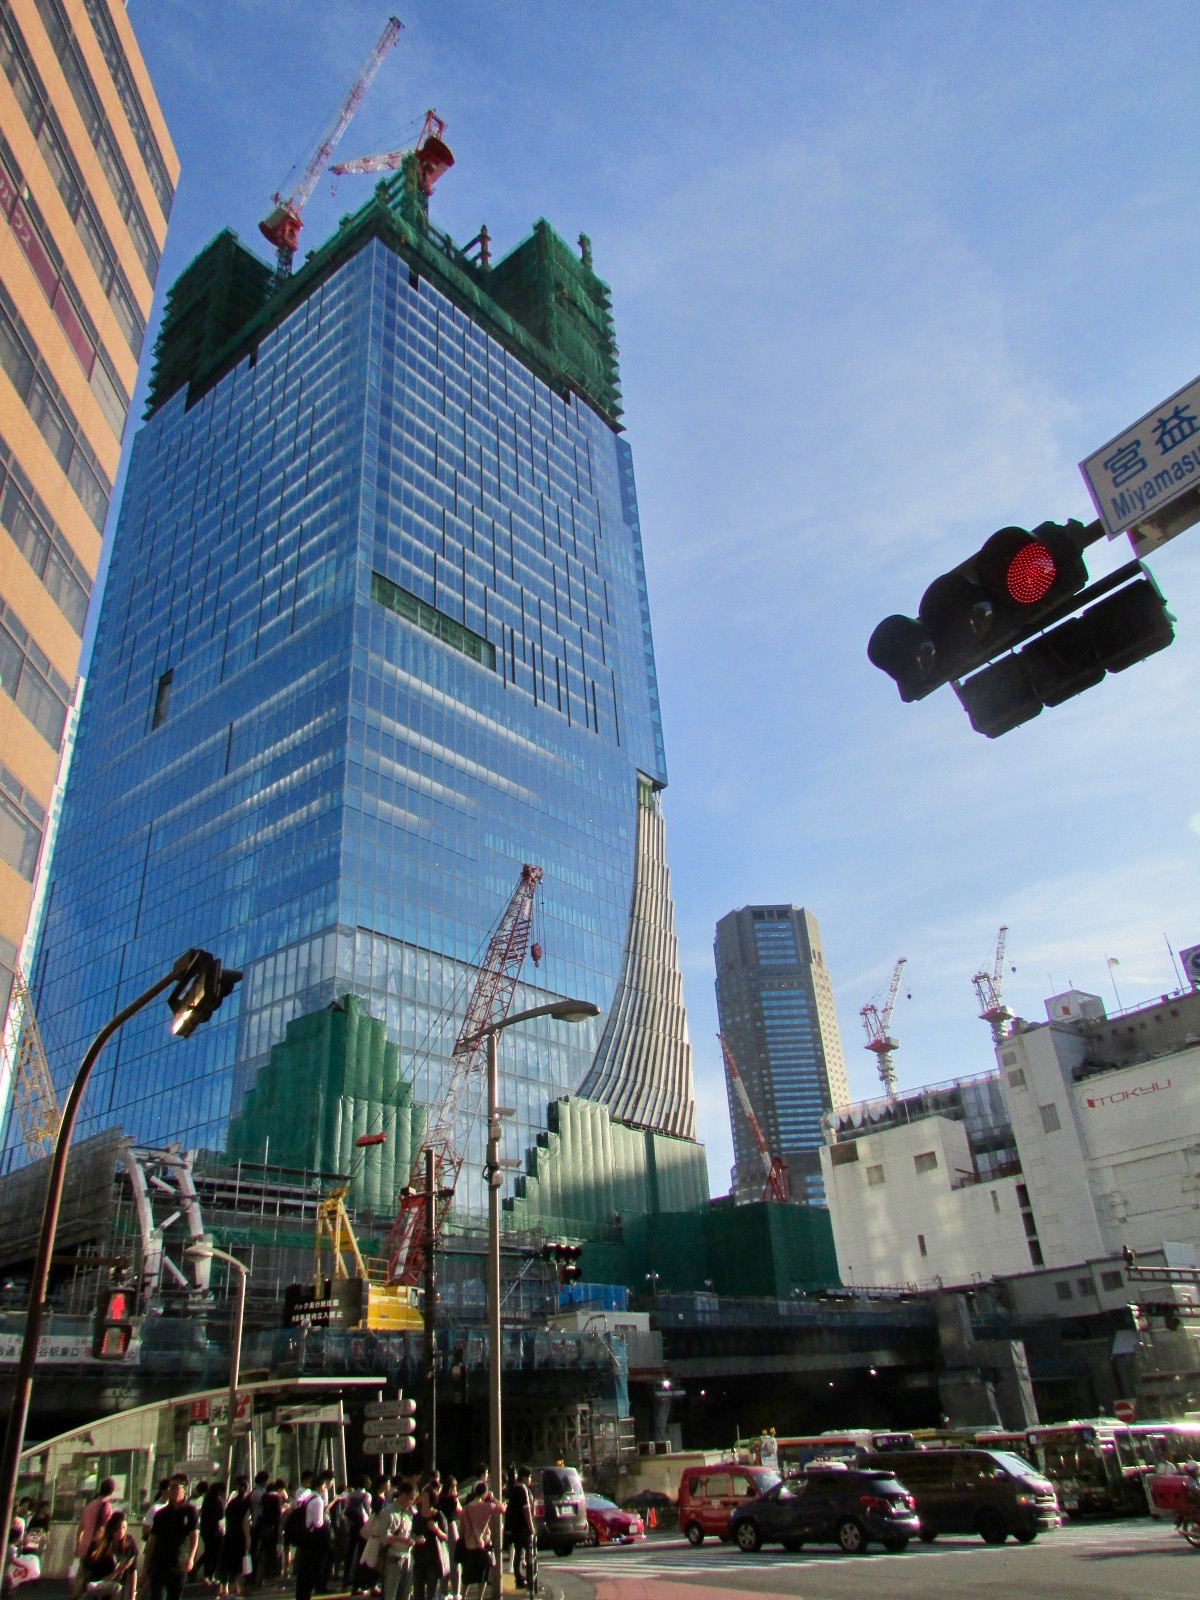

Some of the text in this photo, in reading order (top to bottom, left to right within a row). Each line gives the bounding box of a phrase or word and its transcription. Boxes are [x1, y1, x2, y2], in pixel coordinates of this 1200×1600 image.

[1103, 404, 1200, 488] 宮益
[1095, 1079, 1171, 1105] TOKYU
[39, 1346, 79, 1357] 谷駅東口
